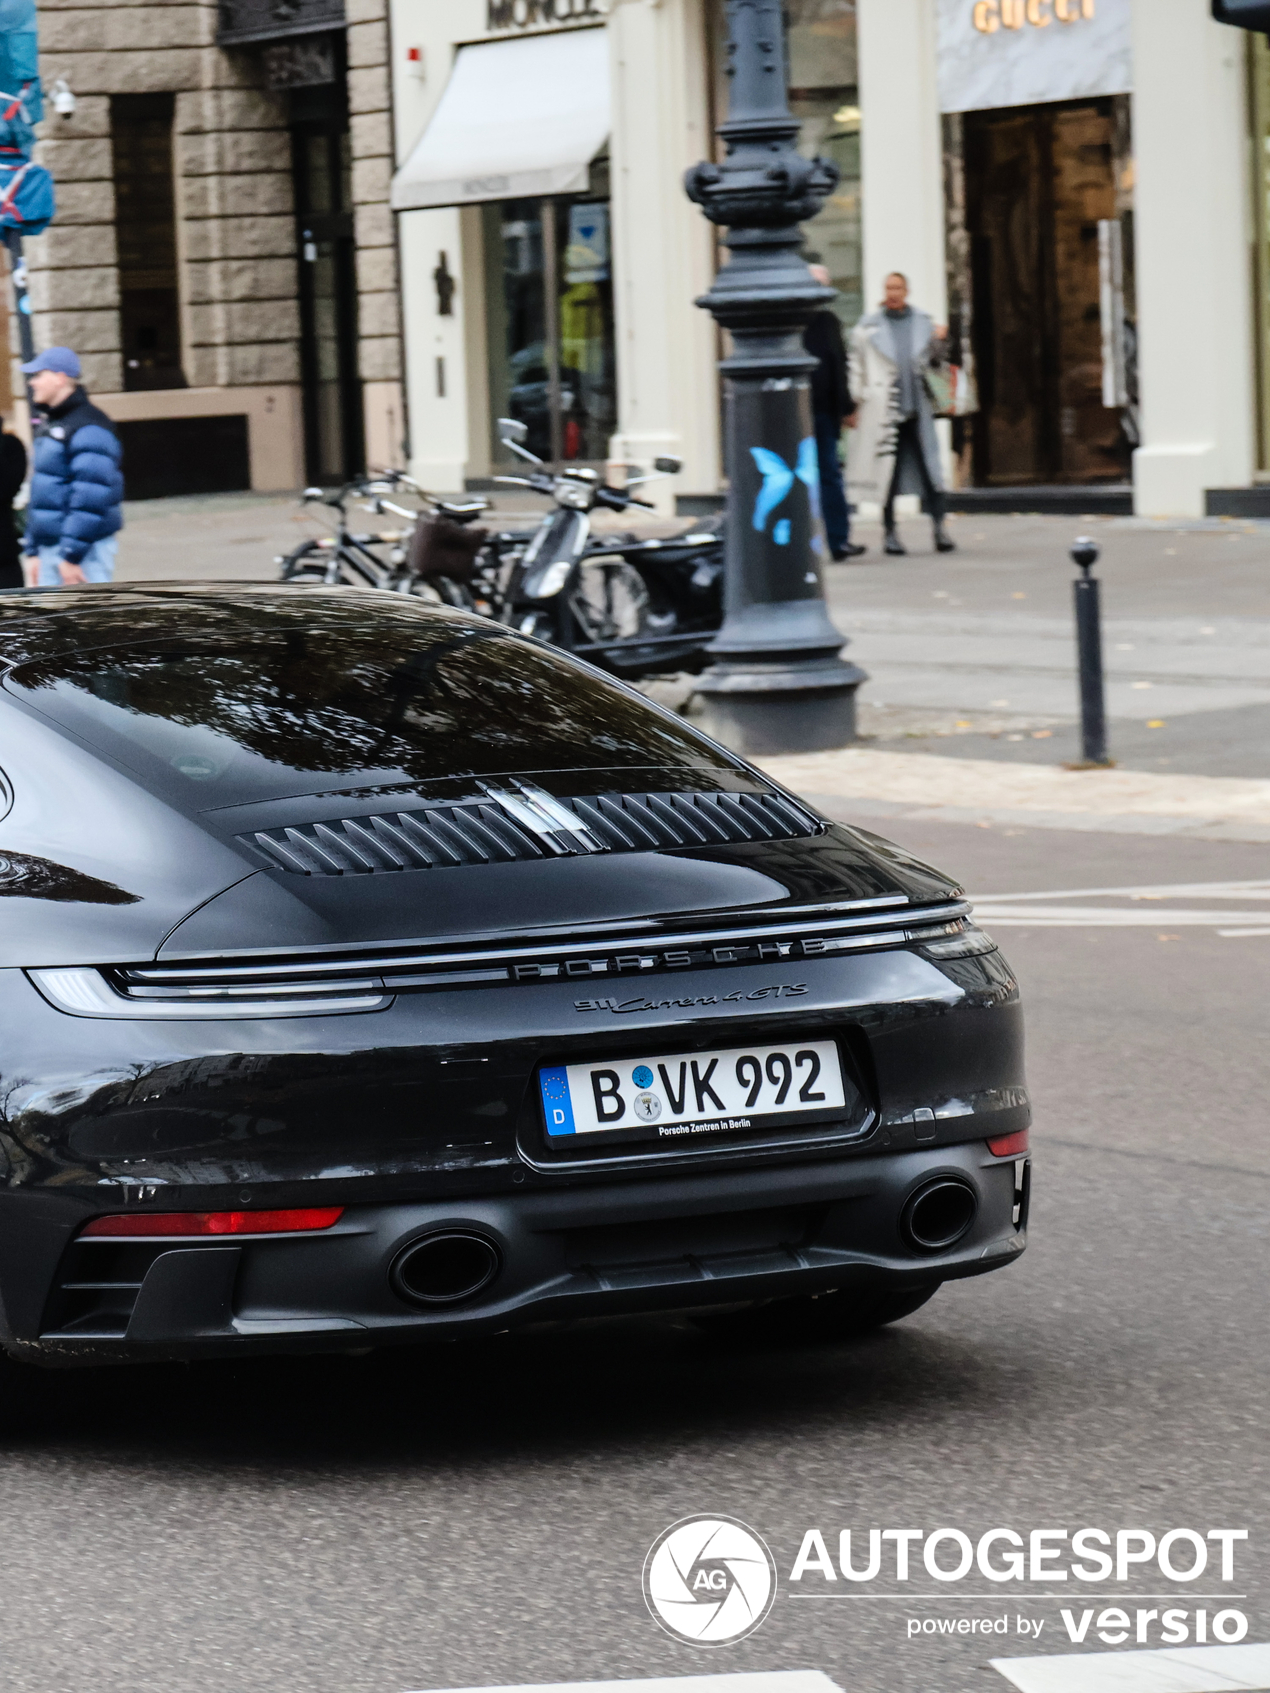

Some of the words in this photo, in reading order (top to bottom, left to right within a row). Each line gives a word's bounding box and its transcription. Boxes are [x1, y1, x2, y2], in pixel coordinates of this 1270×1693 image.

[973, 0, 1095, 33] GUCCI
[512, 937, 827, 980] PORSCHE
[612, 994, 719, 1014] Carrera
[722, 989, 743, 1003] 4
[745, 982, 810, 1001] GTS
[590, 1068, 626, 1123] B
[657, 1057, 727, 1115] VK
[735, 1049, 826, 1108] 992
[552, 1108, 566, 1125] D
[658, 1125, 690, 1136] Porsche
[690, 1122, 720, 1133] Zentren
[720, 1120, 728, 1130] in
[728, 1118, 751, 1129] Berlin
